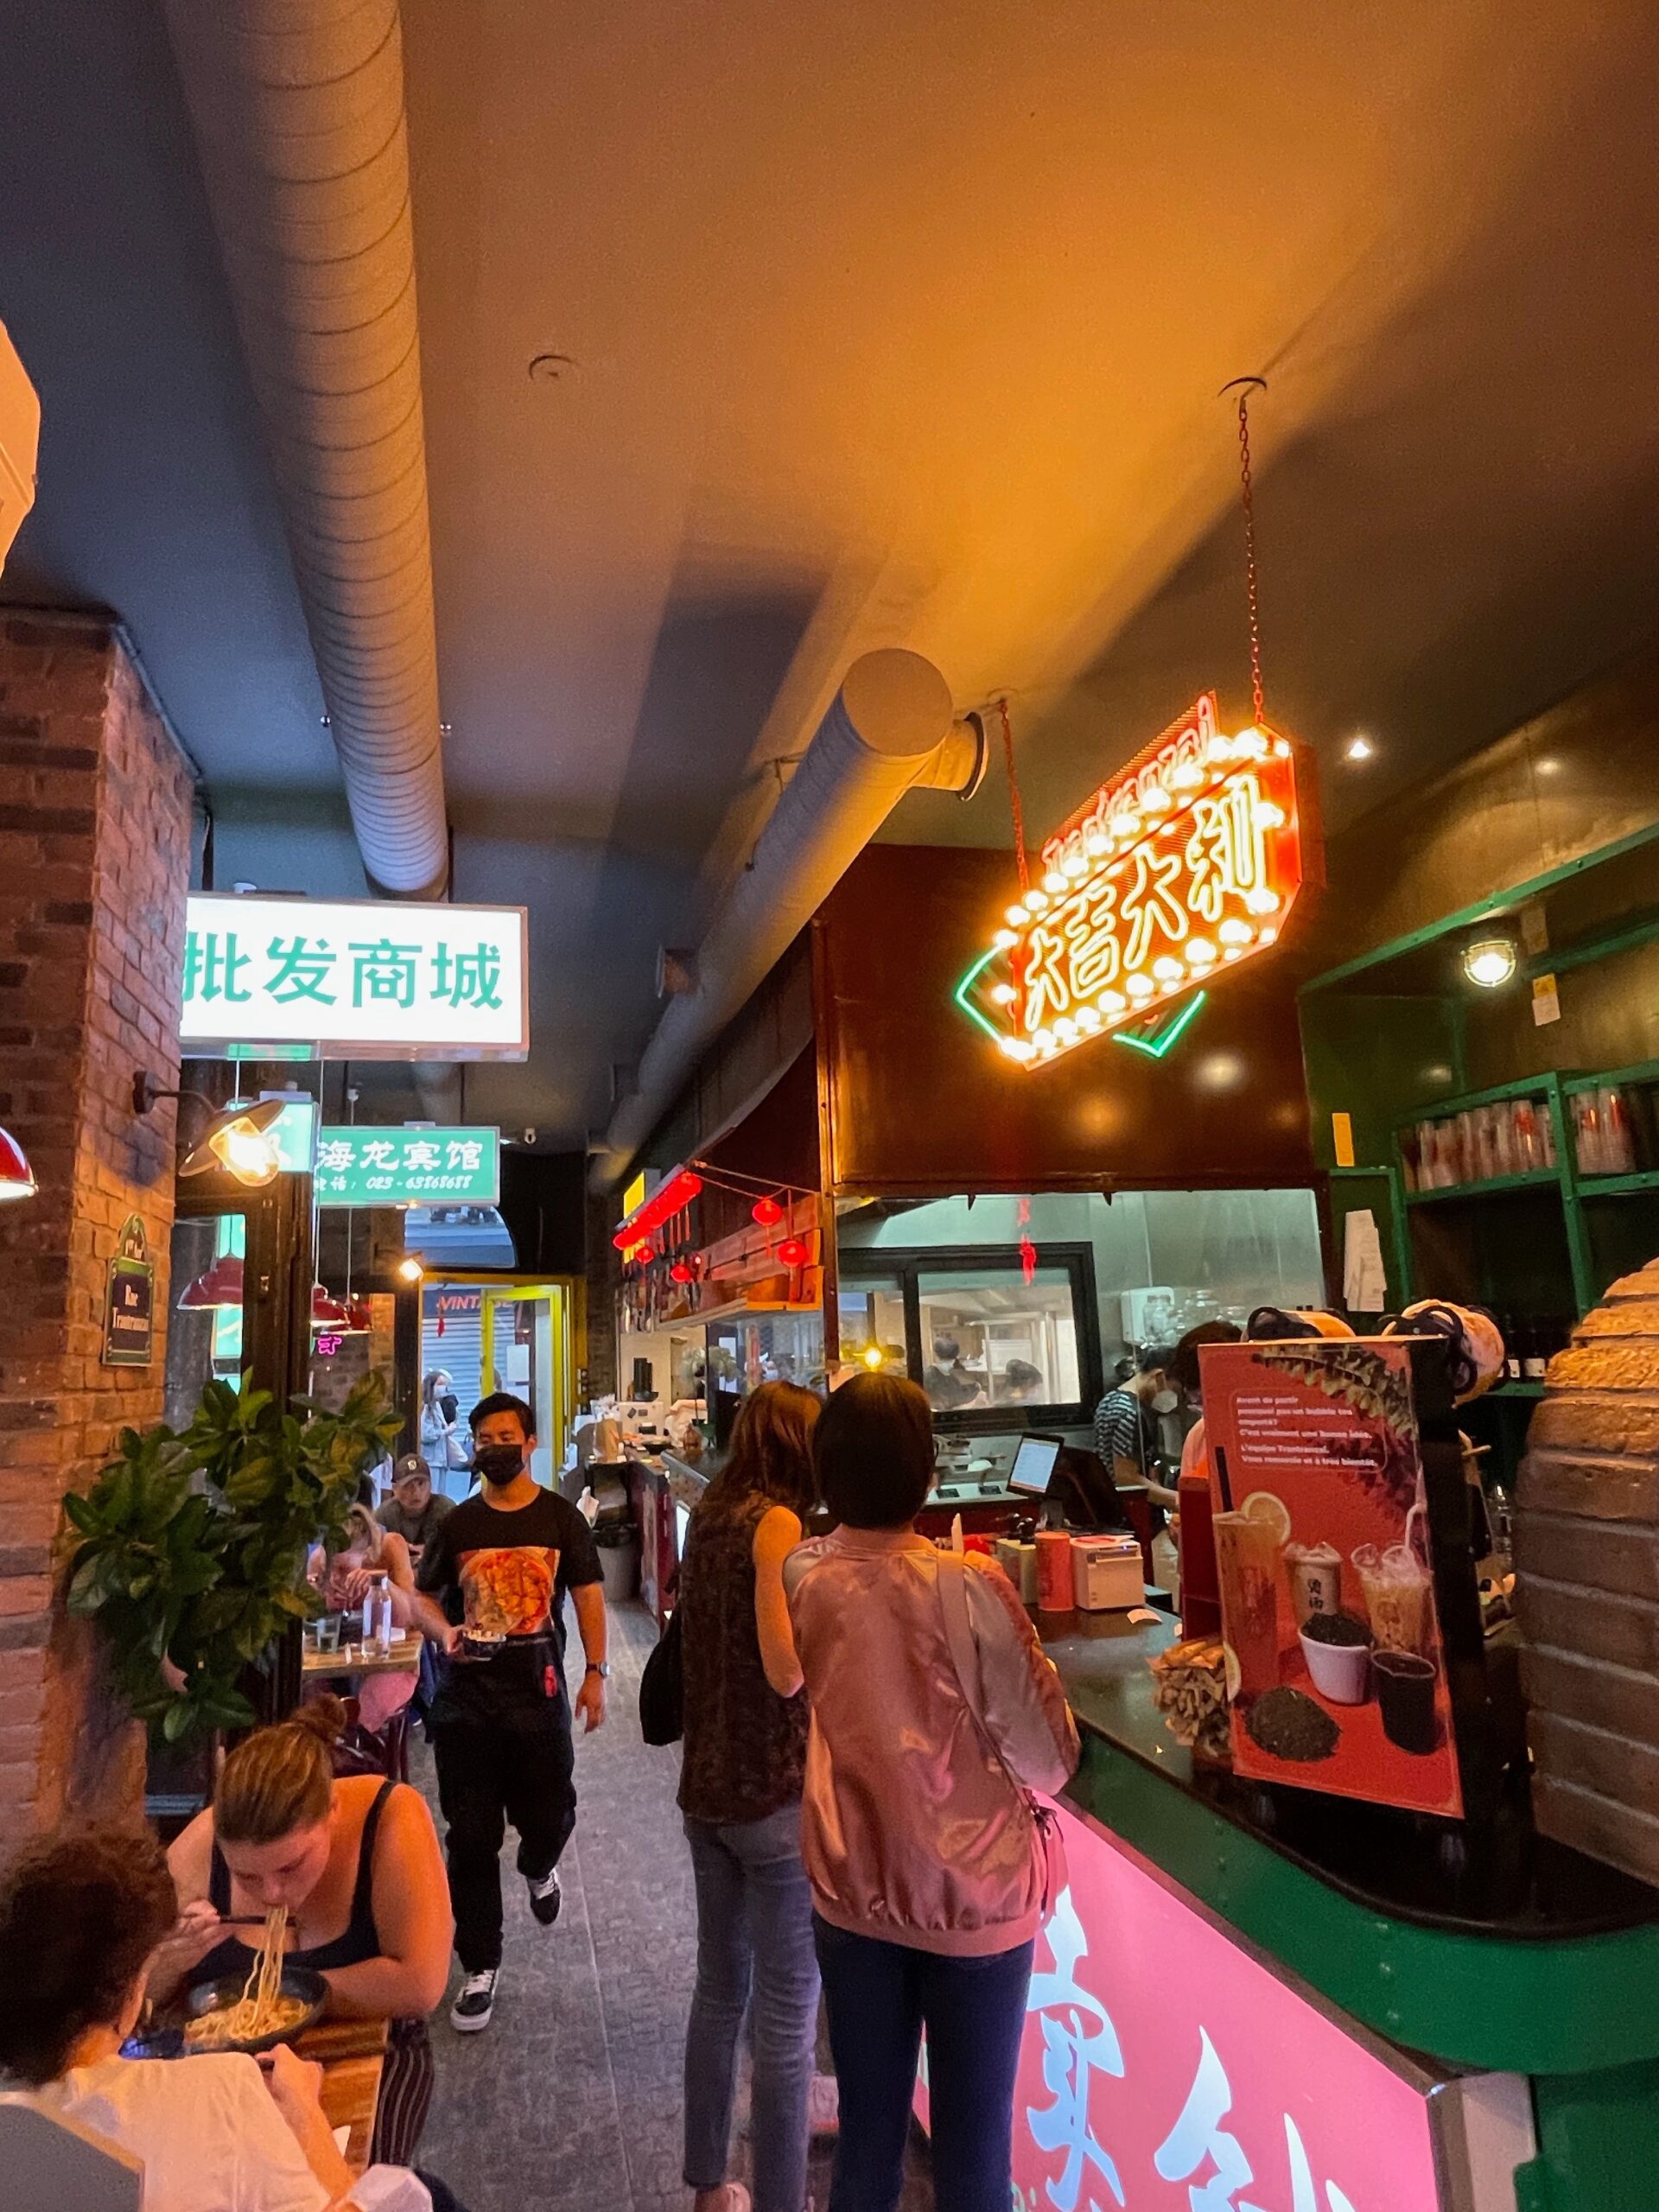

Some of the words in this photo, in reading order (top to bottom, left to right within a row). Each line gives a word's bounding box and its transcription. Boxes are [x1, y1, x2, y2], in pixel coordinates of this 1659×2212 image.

[183, 931, 504, 1010] 批发商城
[317, 1139, 484, 1172] 海龙宾馆
